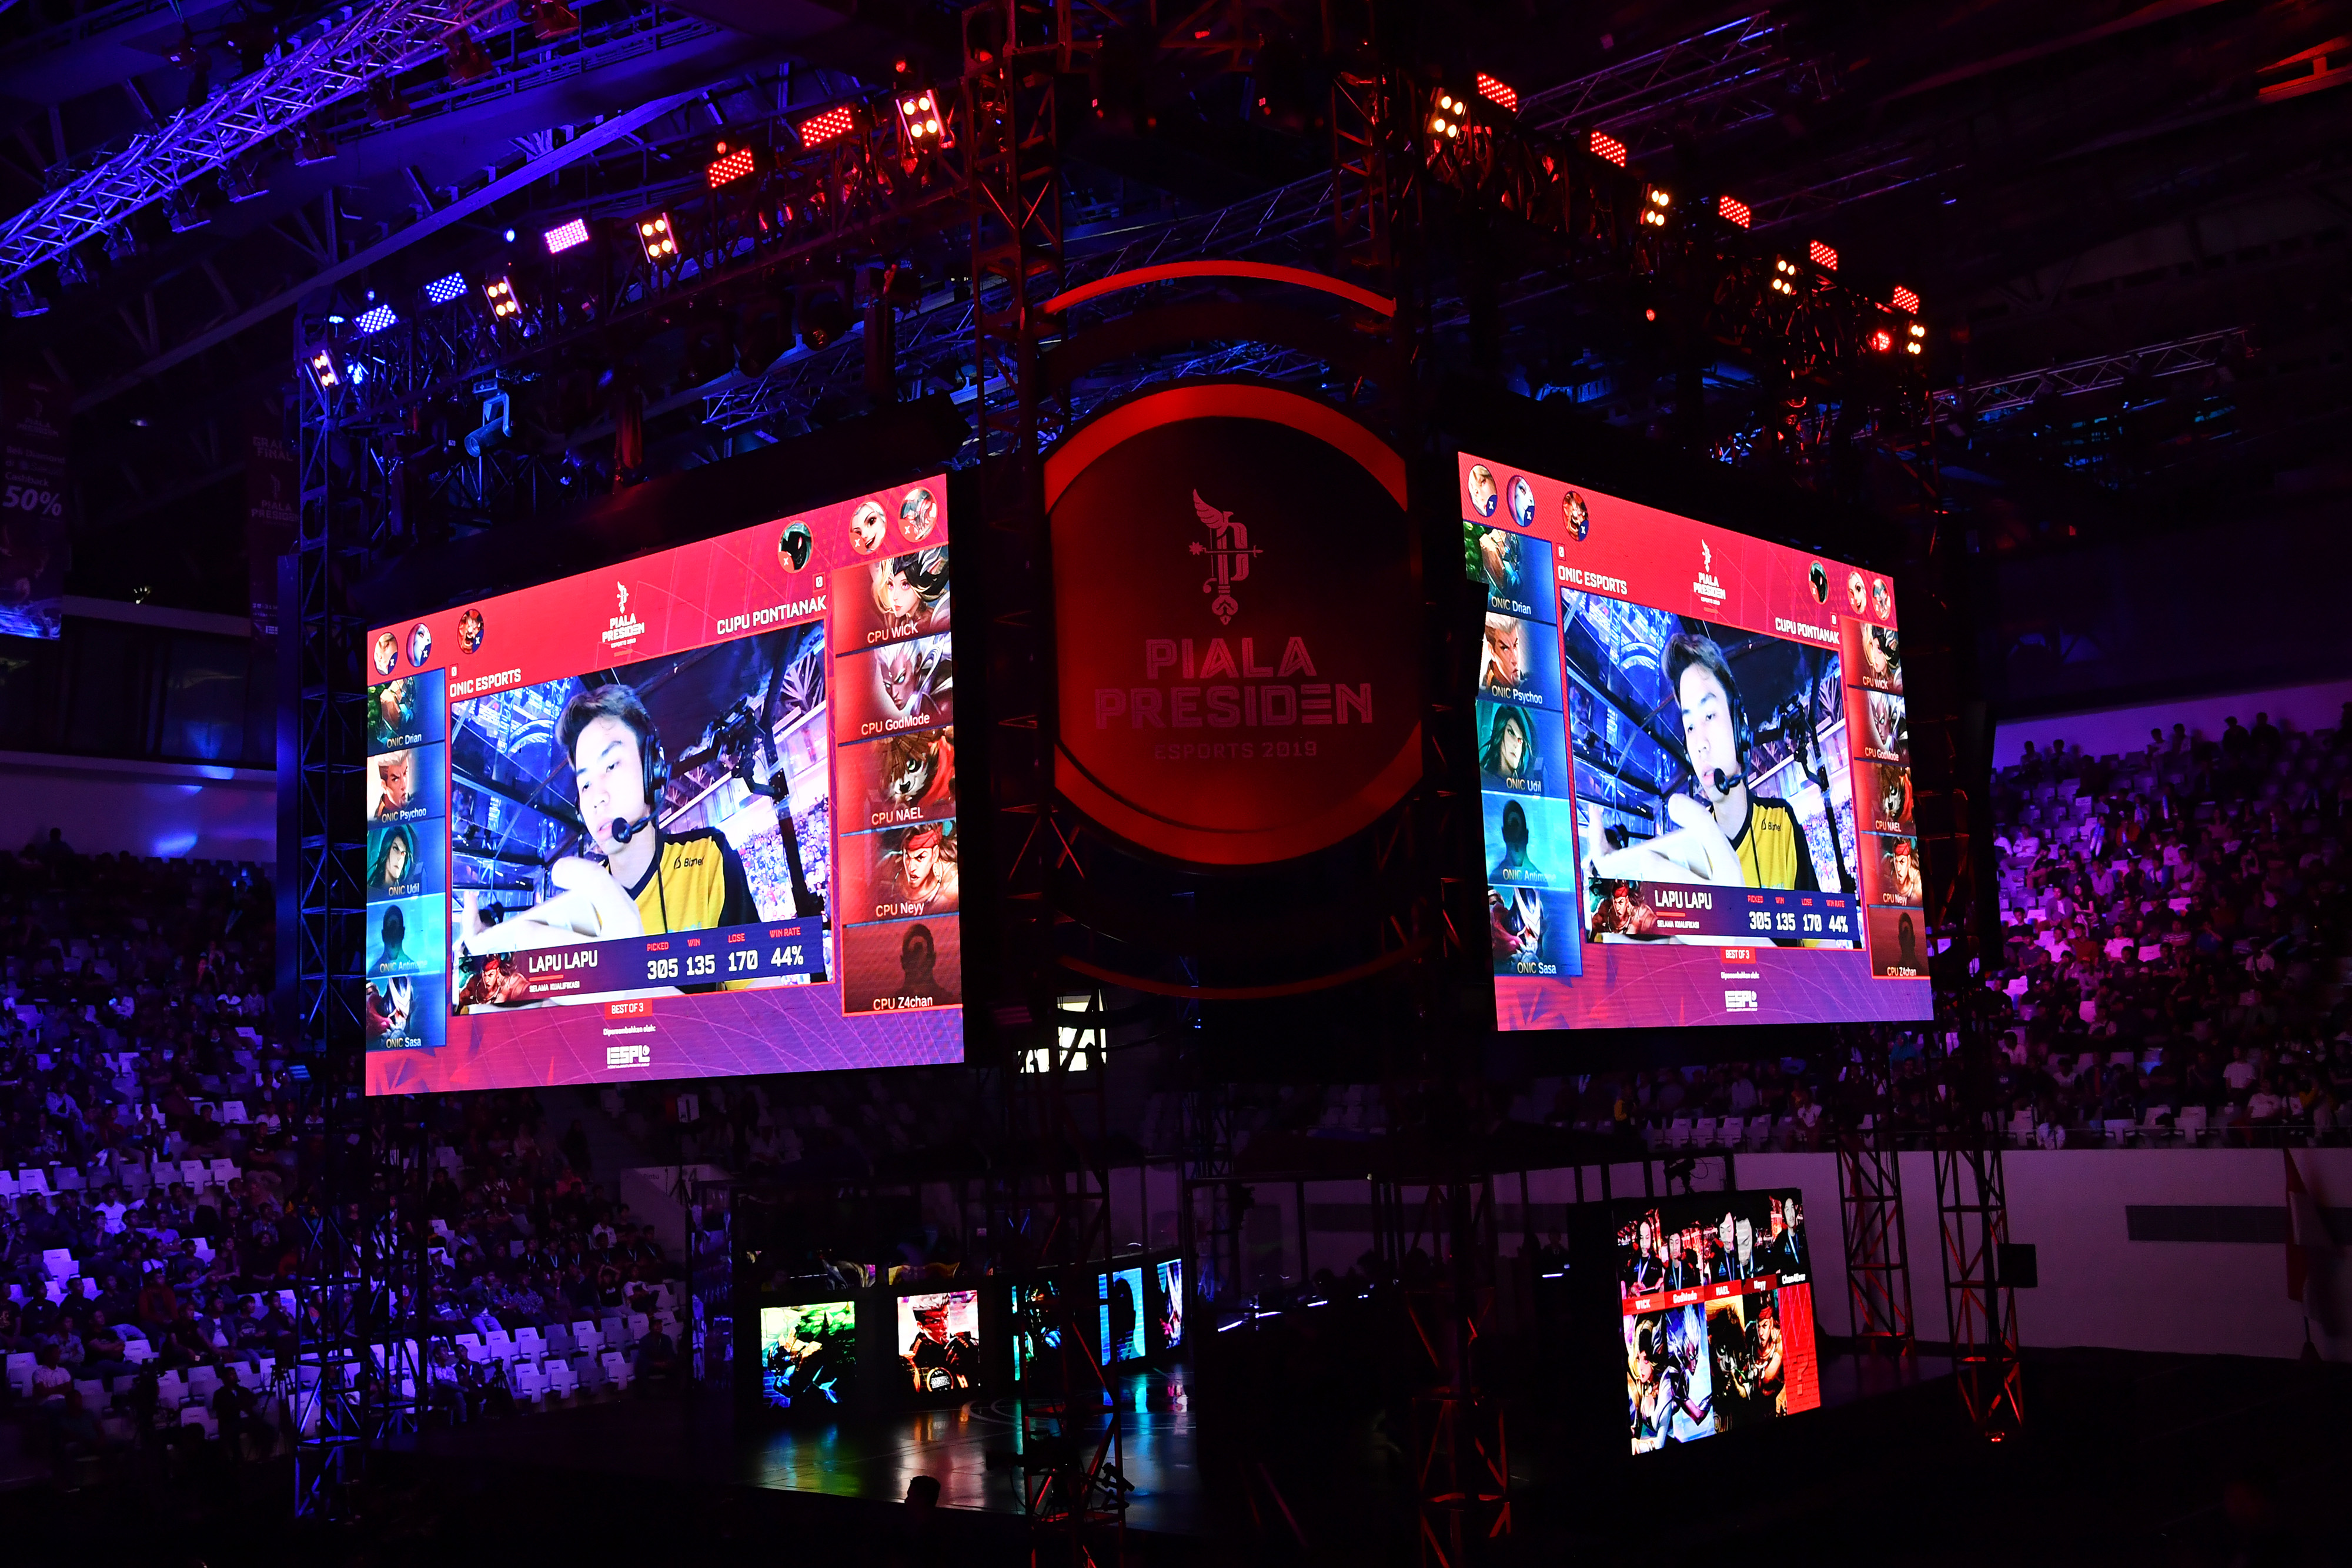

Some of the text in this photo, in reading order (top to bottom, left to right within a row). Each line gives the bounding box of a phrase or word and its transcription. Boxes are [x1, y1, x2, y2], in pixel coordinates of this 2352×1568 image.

[257, 447, 293, 462] FINAL
[5, 472, 49, 487] Cashback
[2, 484, 62, 517] 50%
[262, 499, 292, 512] PIALA
[816, 576, 823, 588] 0
[1558, 565, 1628, 595] ONIC ESPORTS
[1698, 571, 1719, 587] PIALA
[1491, 596, 1532, 615] ONIC Drian
[610, 613, 637, 630] PIALA
[717, 595, 827, 635] CUPU PONTIANAK
[602, 622, 645, 643] PRESIDEN
[867, 622, 918, 644] CPU WICK
[1775, 617, 1840, 644] CUPU PONTIANAK
[1145, 636, 1317, 680] PIALA
[452, 666, 457, 677] 0
[450, 668, 521, 697] ONIC ESPORTS
[1862, 676, 1874, 687] CPU
[1492, 685, 1543, 704] ONIC Psychoo
[1095, 683, 1373, 729] PRESIDEN
[861, 713, 930, 735] CPU GodMode
[387, 734, 422, 748] ONIC Drian
[1154, 741, 1317, 760] ESPORTS 2019
[1865, 747, 1899, 762] CPU GodMode
[1506, 777, 1541, 793] ONIC Udil
[382, 807, 426, 823] ONIC Psychoo
[871, 807, 924, 825] CPU NAEL
[1875, 820, 1902, 833] CPU NAEL
[1503, 868, 1523, 881] ONIC
[389, 882, 420, 897] ONIC Udil
[1654, 890, 1712, 910] LAPU LAPU
[1883, 893, 1895, 904] CPU
[876, 901, 924, 917] CPU Neyy
[1749, 911, 1848, 933] 305 135 170 44%
[647, 927, 801, 951] PICKED WIN LOSE WIN RATE
[529, 950, 598, 973] LAPU LAPU
[1725, 949, 1738, 959] BEST
[1745, 950, 1750, 959] 3
[380, 962, 397, 973] ONIC
[647, 945, 804, 980] 305 135 170 44%
[1517, 962, 1556, 975] ONIC Sasa
[1887, 967, 1899, 976] CPU
[529, 984, 549, 992] SELAMA
[612, 1002, 644, 1014] BEST OF 3
[873, 995, 933, 1010] CPU Z4chan
[386, 1036, 422, 1048] ONIC Sasa
[1635, 1299, 1651, 1310] WICK
[1715, 1285, 1730, 1296] NAEL
